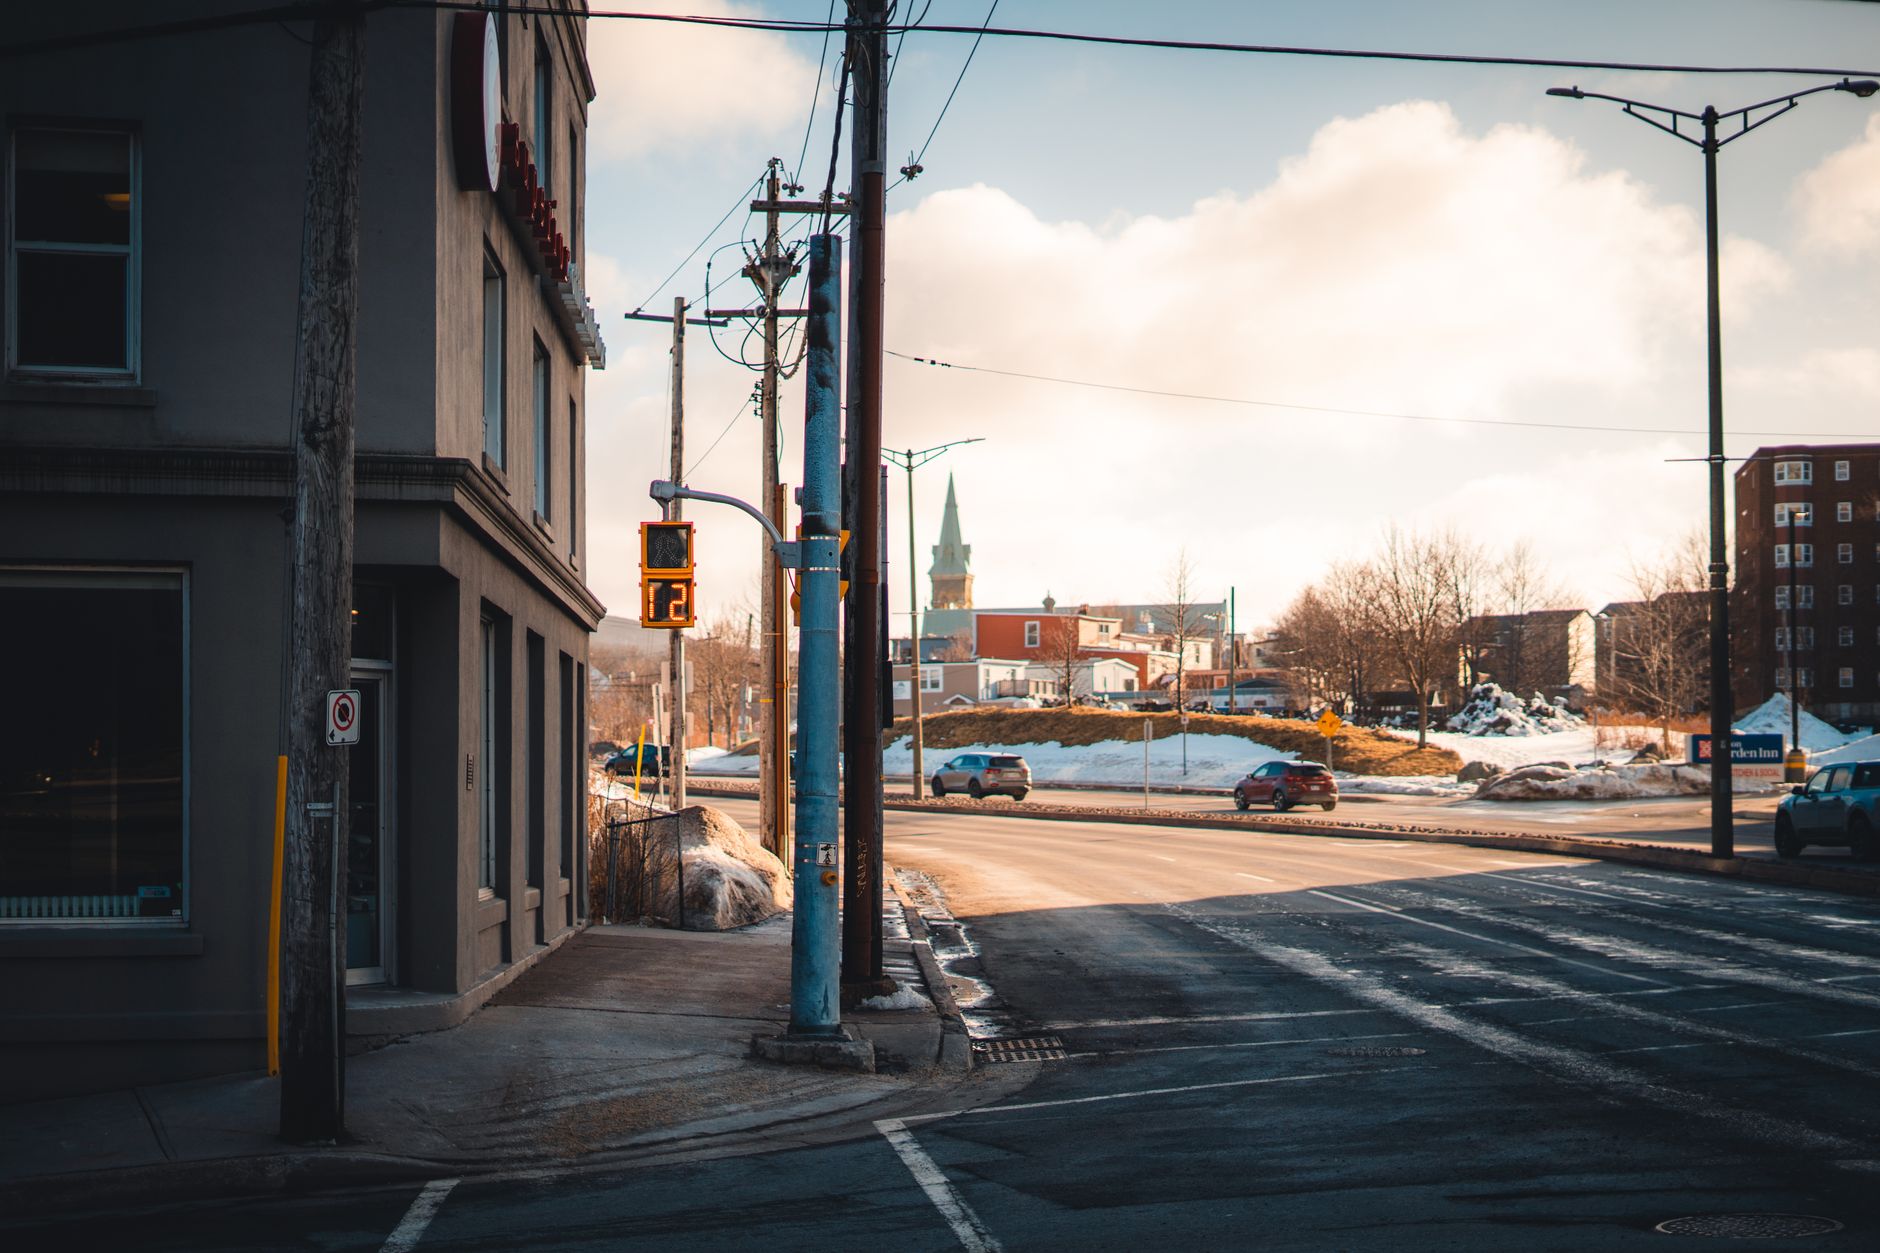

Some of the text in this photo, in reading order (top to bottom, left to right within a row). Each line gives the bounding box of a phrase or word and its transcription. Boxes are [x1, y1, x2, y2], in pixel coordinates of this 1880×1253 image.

[649, 584, 687, 621] 12
[1730, 747, 1778, 758] rden Inn
